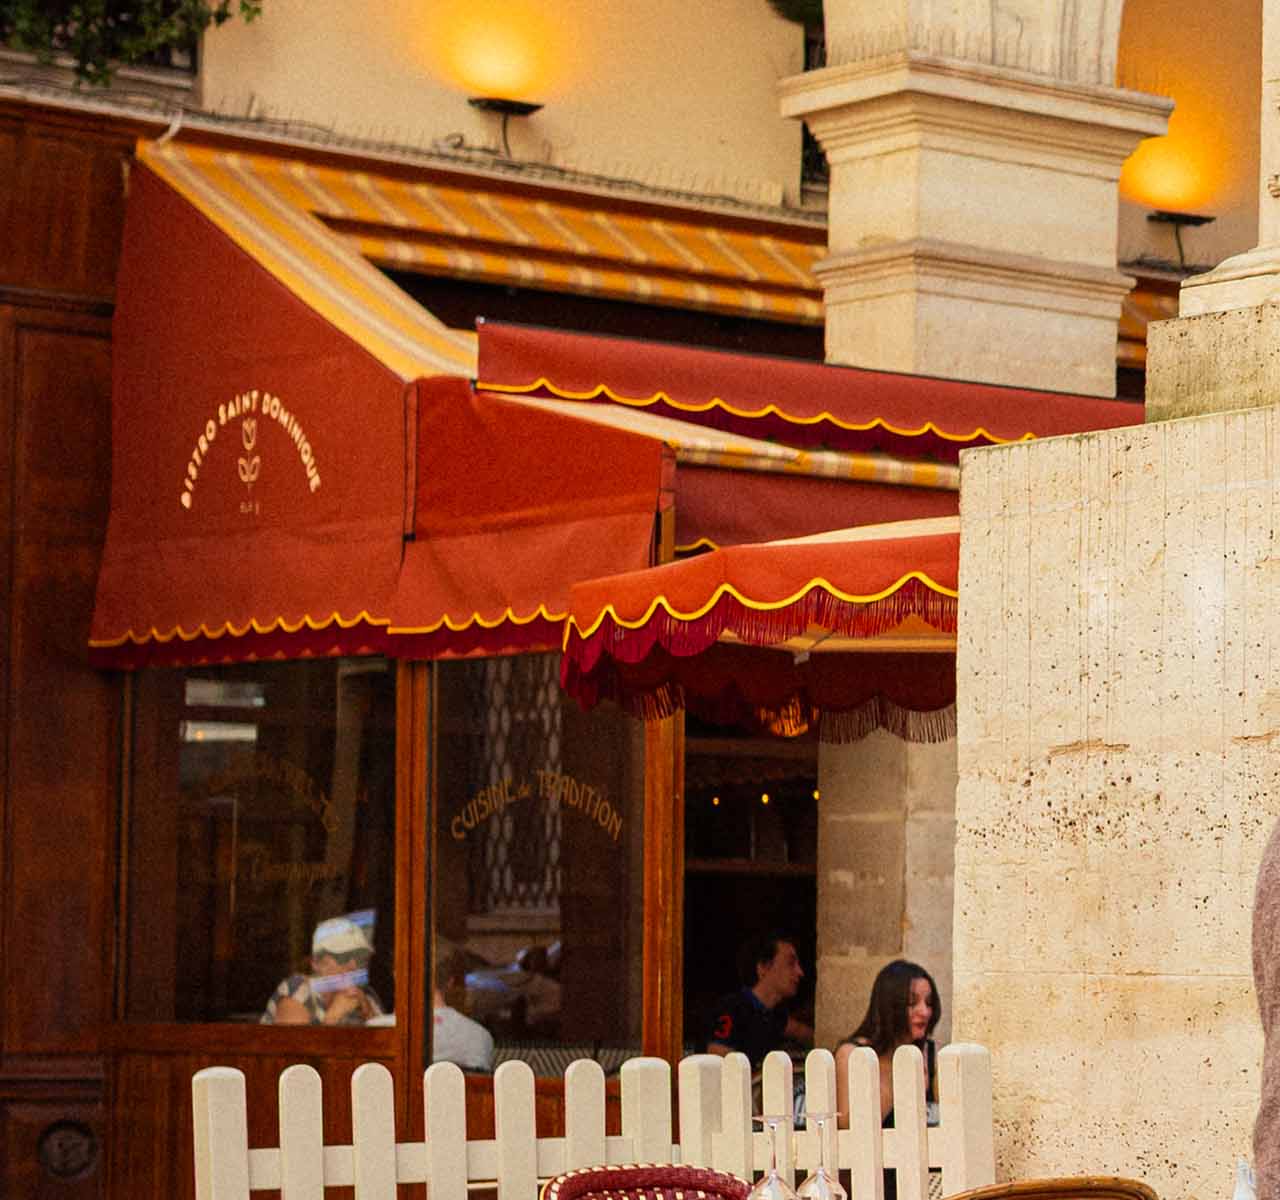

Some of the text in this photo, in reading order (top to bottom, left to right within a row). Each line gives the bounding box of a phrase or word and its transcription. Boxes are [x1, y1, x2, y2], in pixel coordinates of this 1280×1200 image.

[217, 390, 260, 426] SAINT
[261, 392, 322, 493] DOMINIQUE
[450, 776, 516, 841] CUISINE
[536, 769, 623, 841] TRADITION
[713, 1015, 733, 1039] 3
